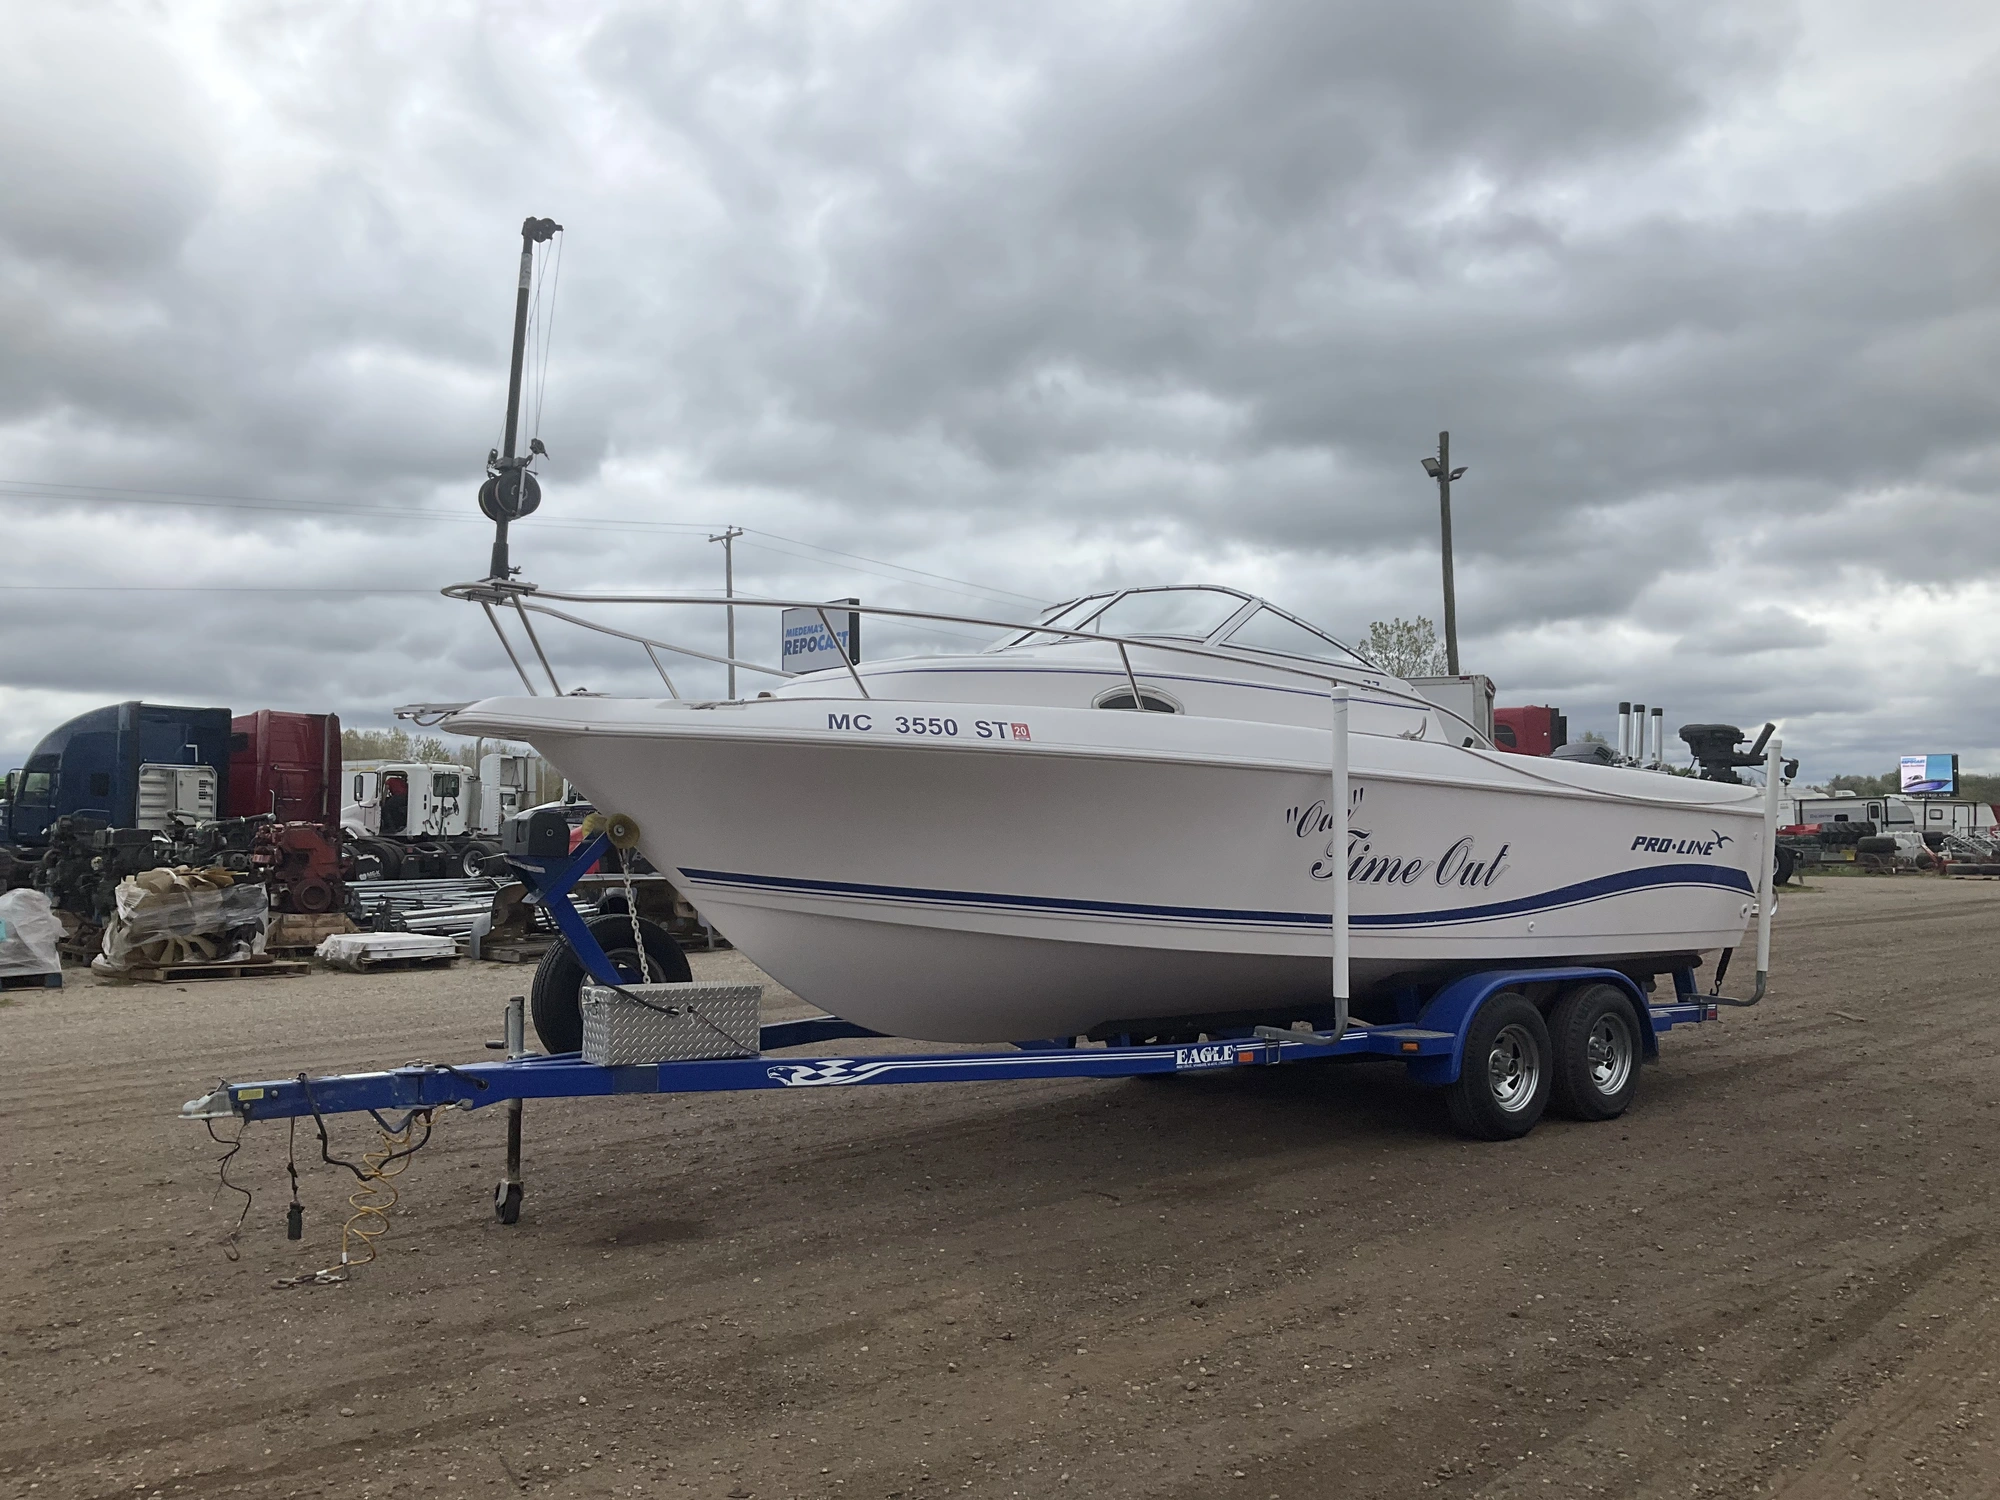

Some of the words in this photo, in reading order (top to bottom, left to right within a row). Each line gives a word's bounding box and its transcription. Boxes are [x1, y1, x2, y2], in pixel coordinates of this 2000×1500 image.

[785, 623, 824, 638] MIEDEMA'S
[827, 713, 873, 731] MC
[895, 716, 958, 736] 3550
[975, 720, 1008, 739] ST
[1014, 726, 1027, 736] 20
[1286, 787, 1364, 838] "Ou"
[1310, 827, 1434, 885] Time
[1435, 835, 1511, 888] Out
[1175, 1044, 1234, 1065] EAGLE
